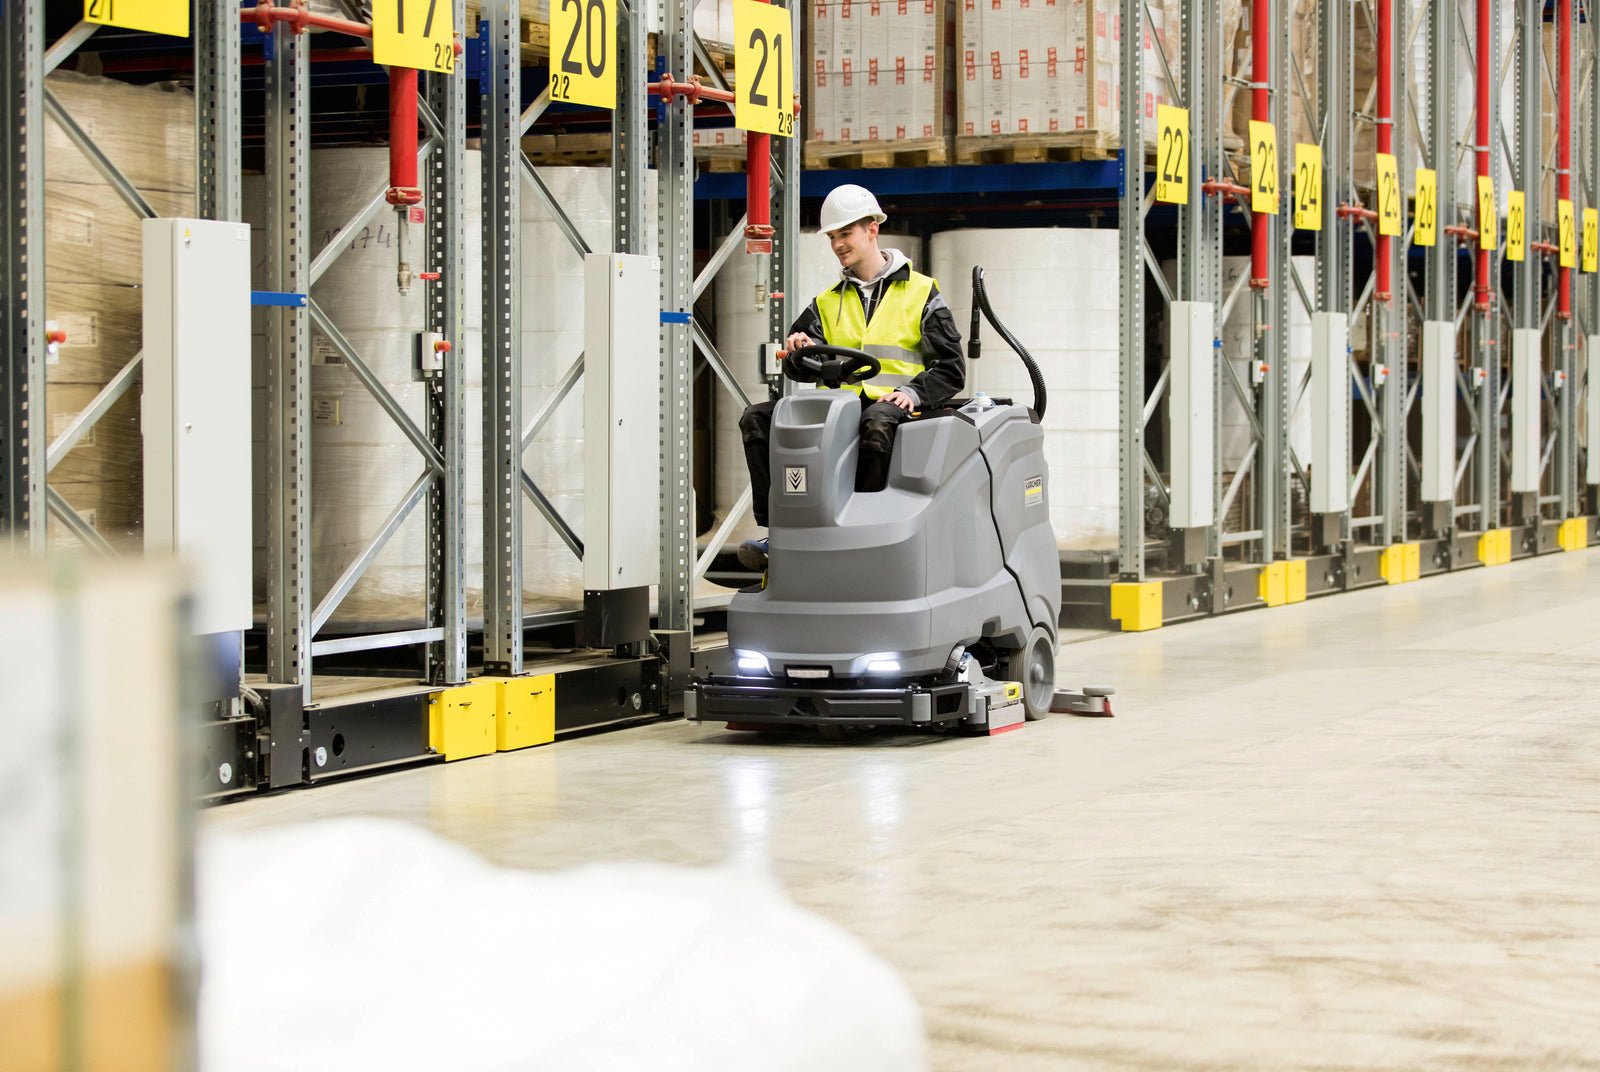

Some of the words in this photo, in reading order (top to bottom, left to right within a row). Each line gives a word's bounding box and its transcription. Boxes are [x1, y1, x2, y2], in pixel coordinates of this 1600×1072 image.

[561, 0, 607, 78] 20
[551, 73, 570, 100] 2/2
[749, 28, 783, 110] 21
[778, 112, 793, 134] 2/3
[1163, 126, 1184, 184] 22
[1257, 140, 1275, 195] 23
[1300, 162, 1317, 213] 24
[1419, 184, 1433, 229] 26
